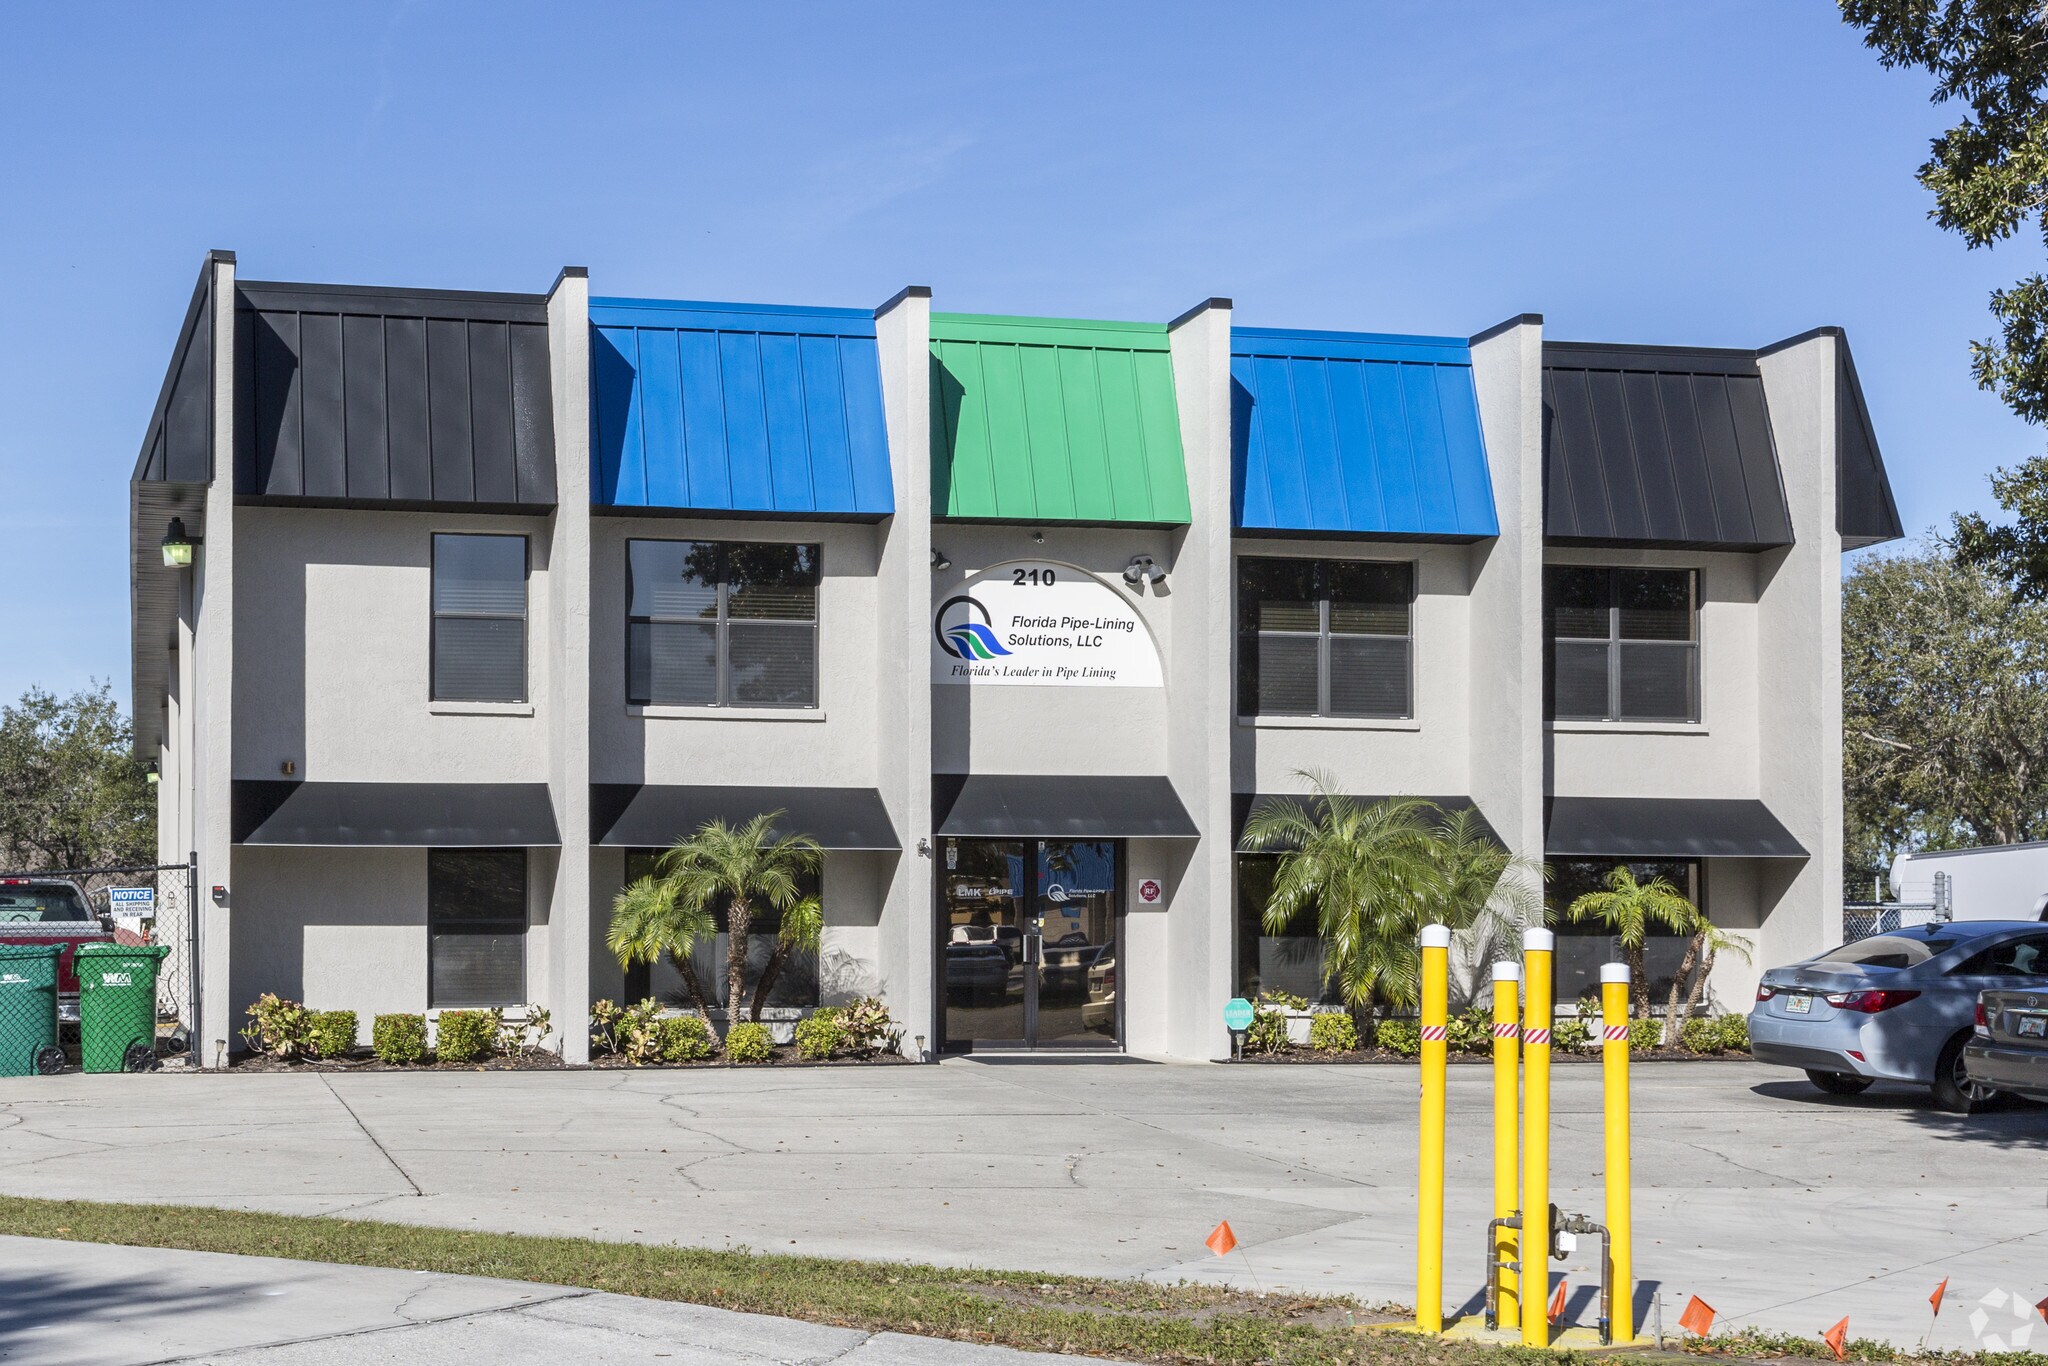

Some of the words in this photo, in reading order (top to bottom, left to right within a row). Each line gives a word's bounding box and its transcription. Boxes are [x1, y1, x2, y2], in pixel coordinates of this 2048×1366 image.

[1012, 568, 1056, 587] 210
[1011, 615, 1057, 628] Florida
[1061, 616, 1135, 632] Pipe-Lining
[1008, 633, 1073, 649] Solutions,
[1077, 635, 1103, 648] LLC
[951, 664, 1000, 677] Florida's
[1003, 665, 1040, 677] Leader
[1042, 666, 1053, 677] in
[1056, 666, 1079, 680] Pipe
[1082, 666, 1117, 681] Lining
[113, 890, 151, 900] NOTICE
[958, 888, 981, 897] LMK
[1145, 887, 1155, 895] RF
[102, 972, 132, 983] WM
